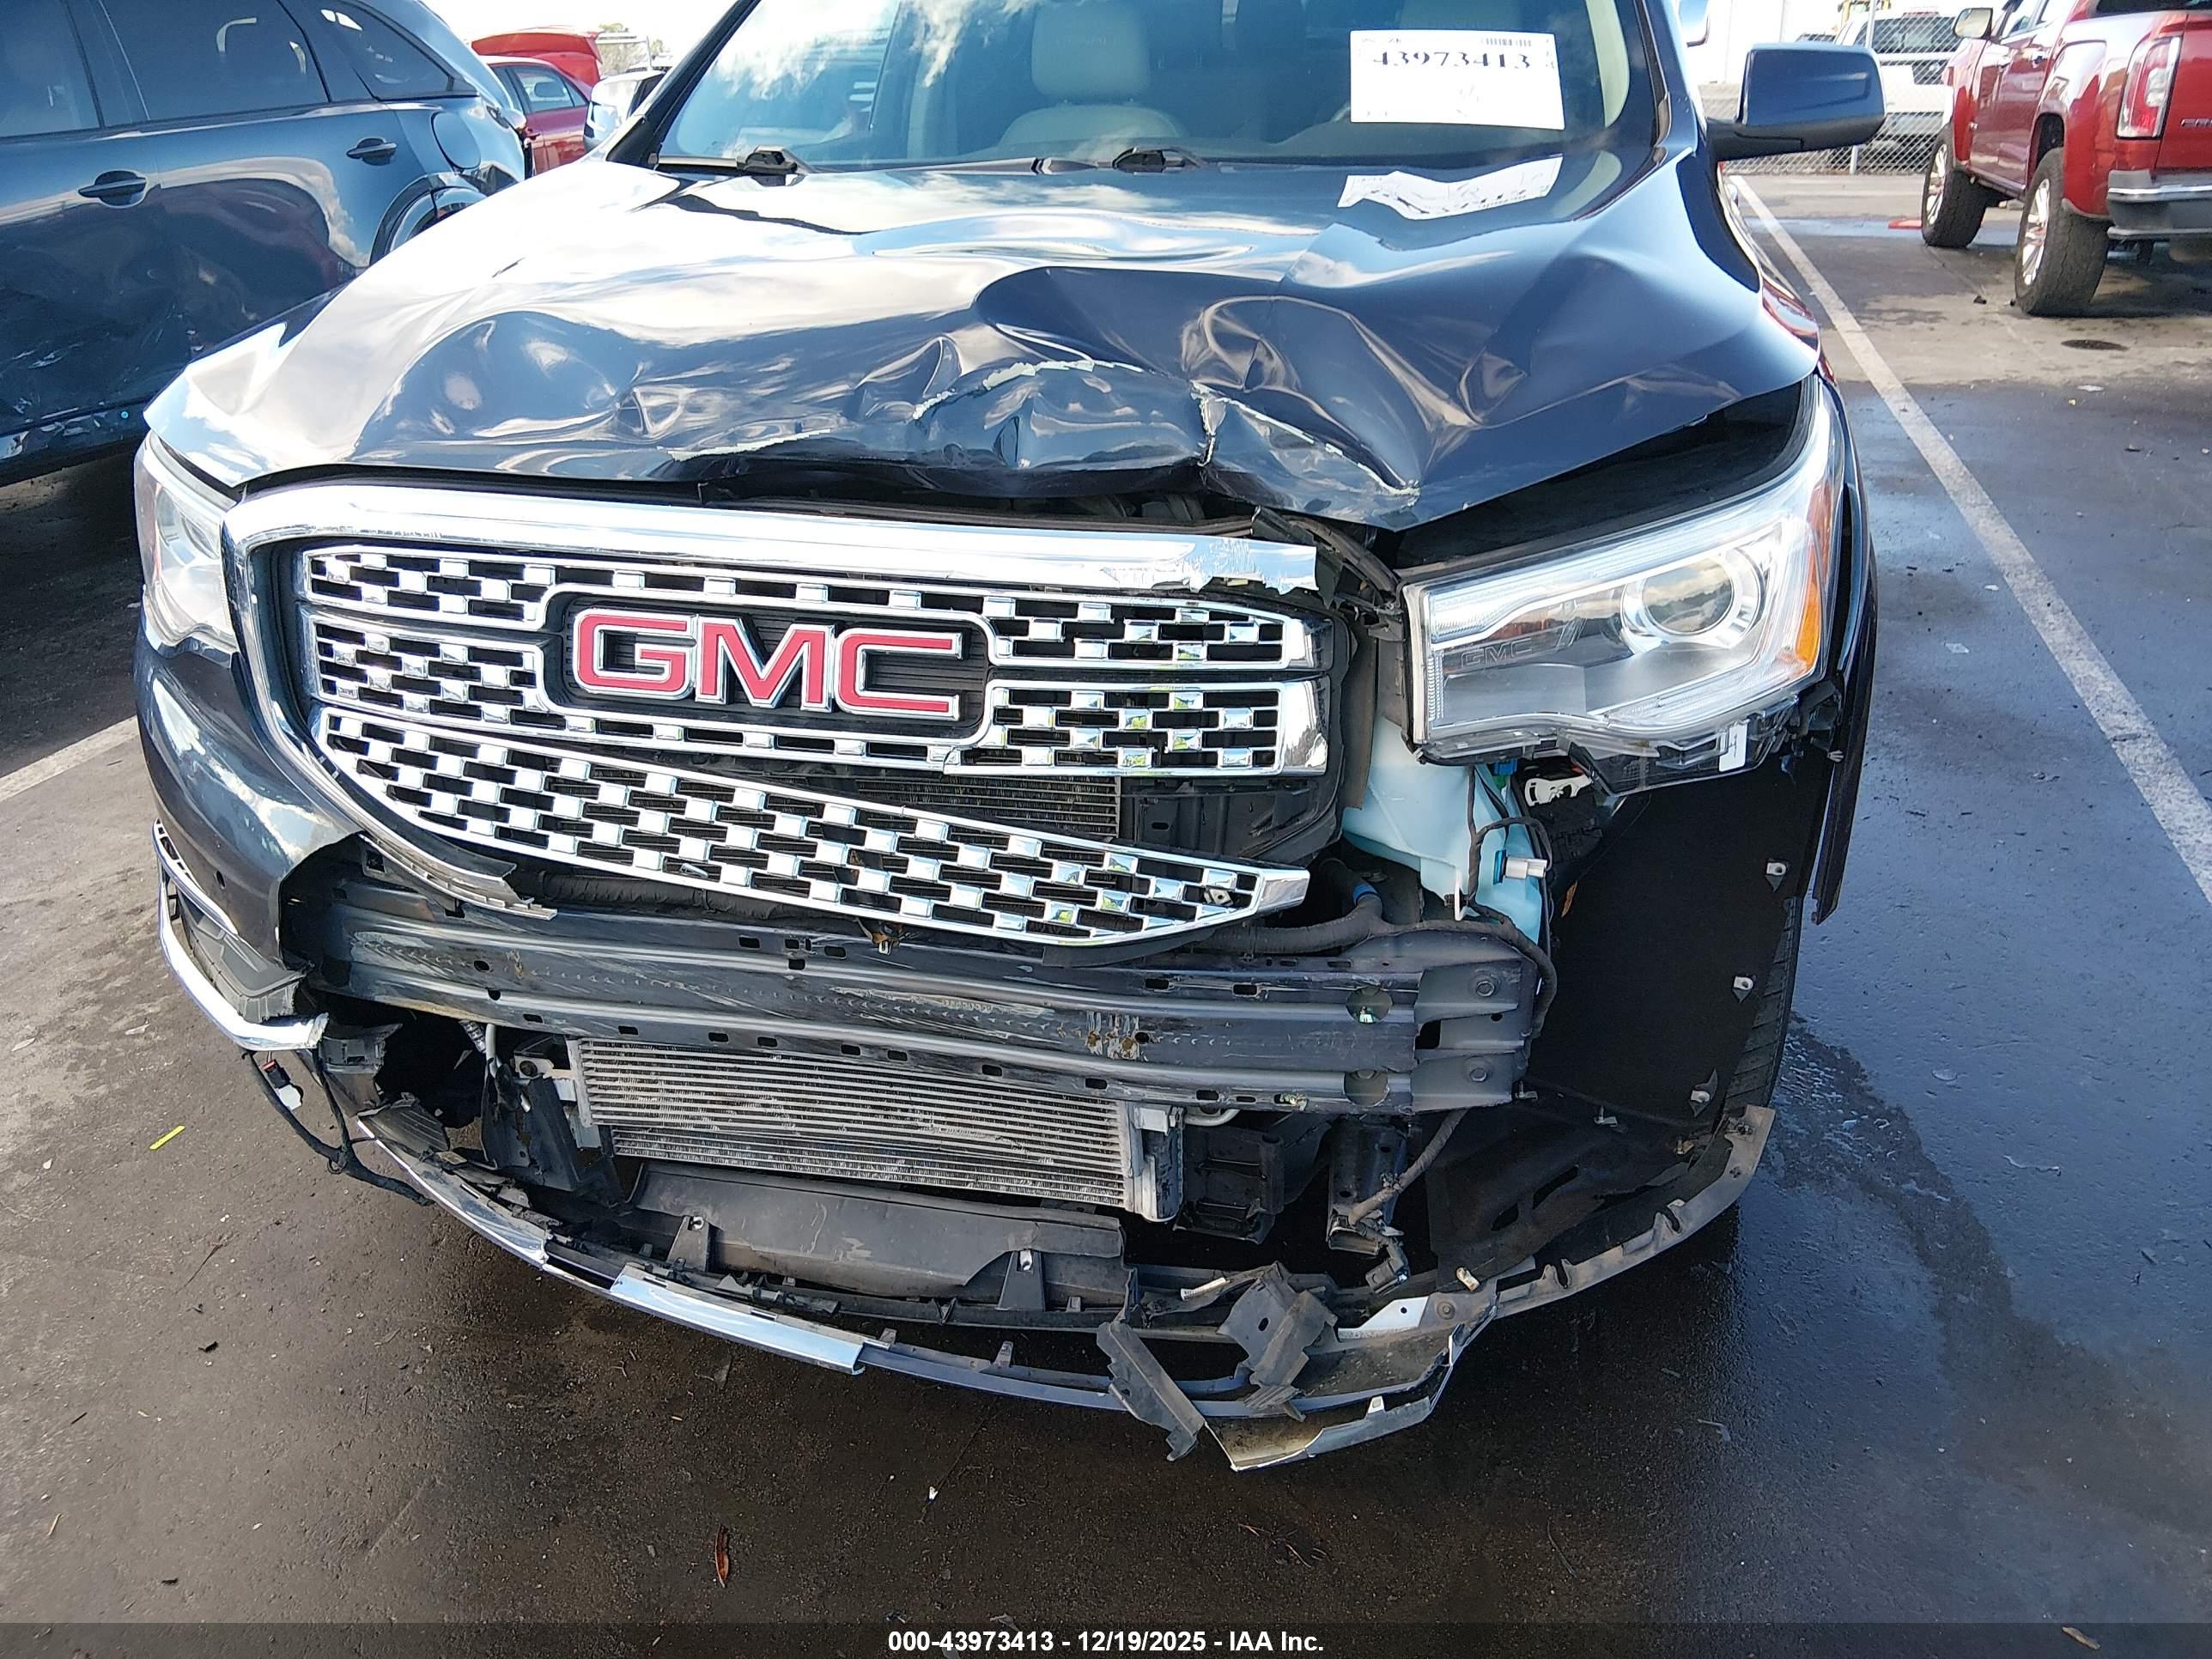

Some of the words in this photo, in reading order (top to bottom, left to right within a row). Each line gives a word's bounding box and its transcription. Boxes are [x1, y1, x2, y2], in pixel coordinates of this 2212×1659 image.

[1373, 51, 1531, 69] 43973413
[573, 607, 965, 722] GMC
[1460, 637, 1533, 668] GMC
